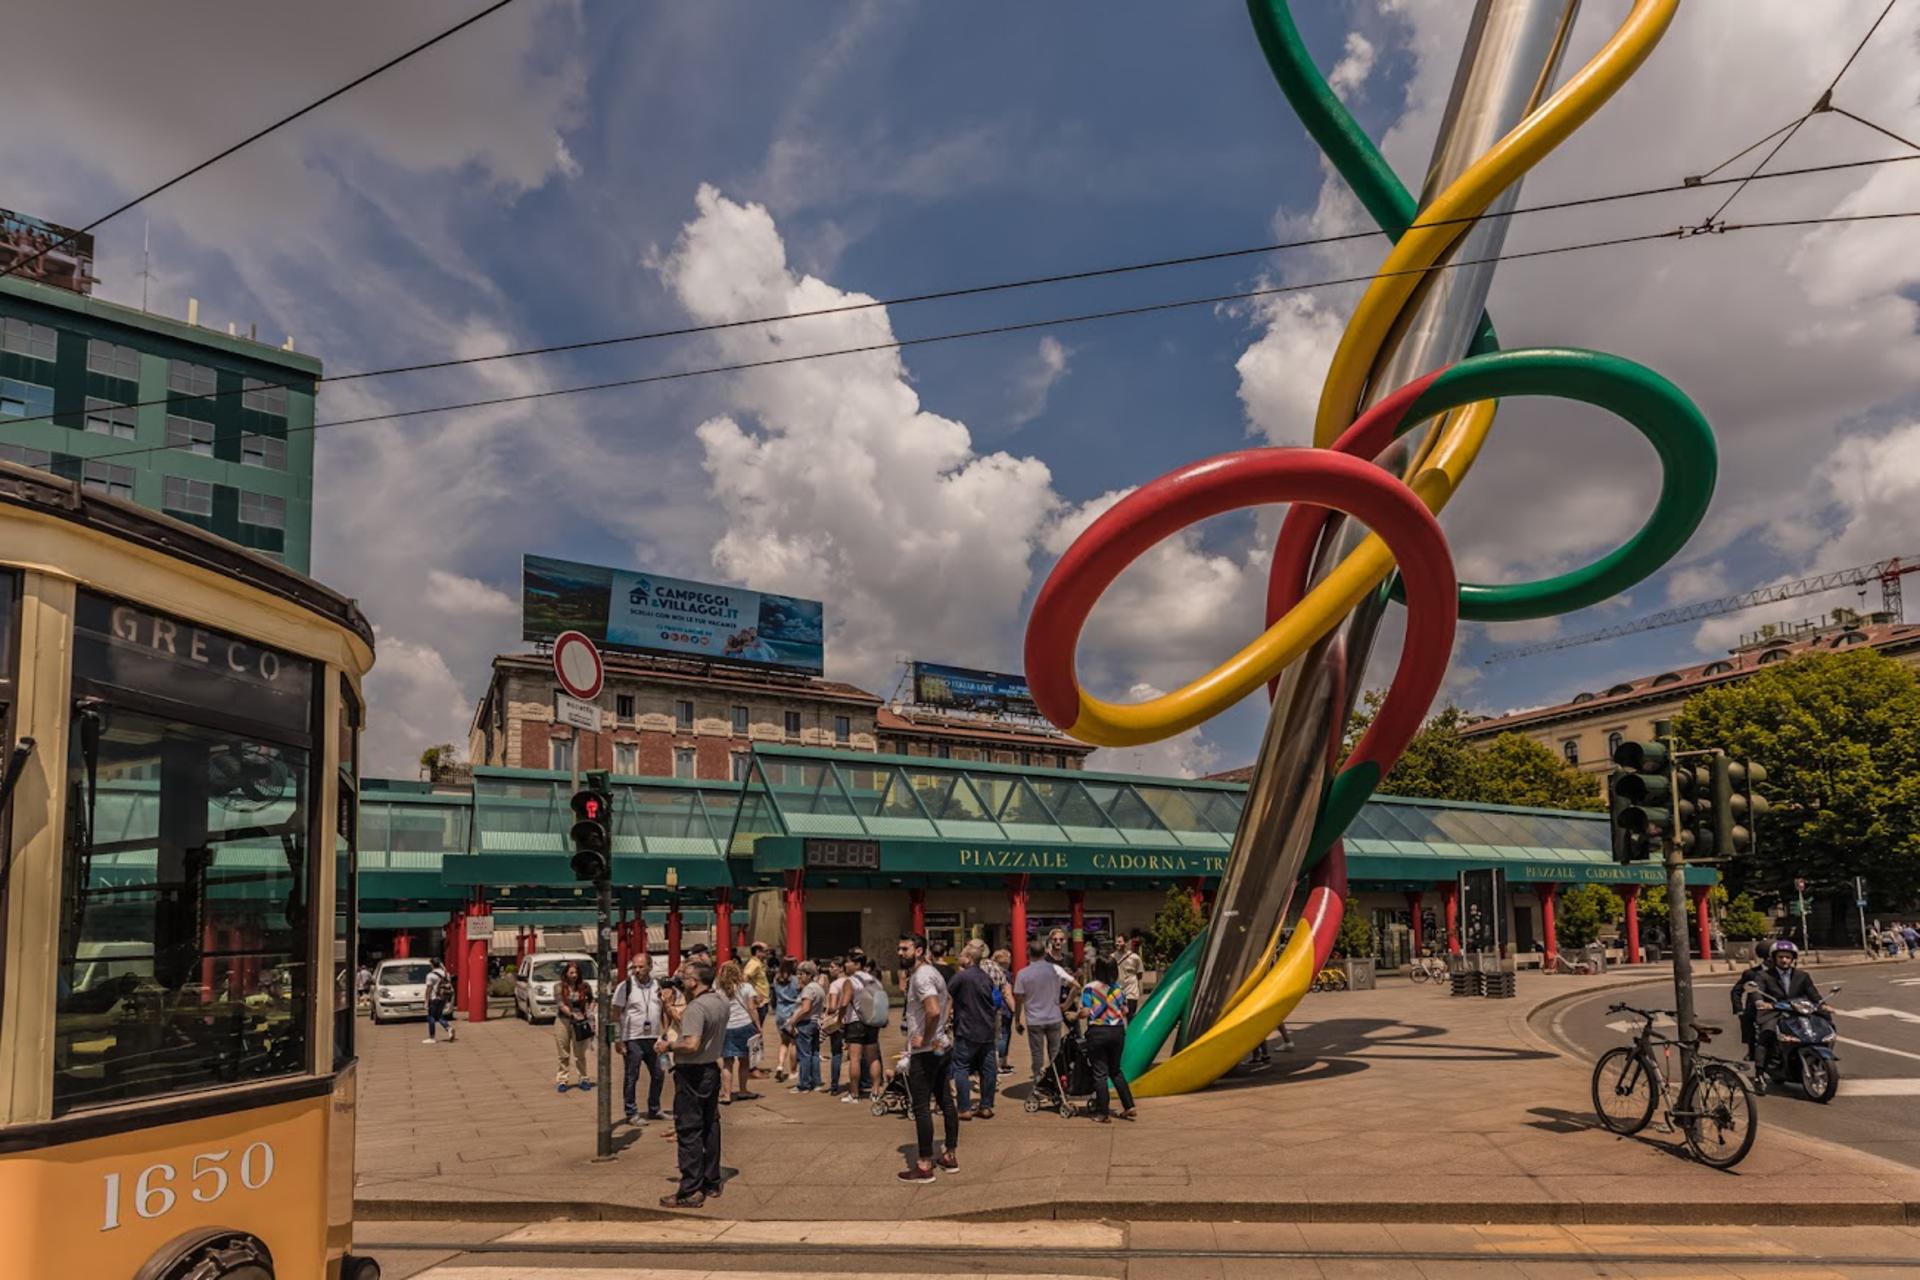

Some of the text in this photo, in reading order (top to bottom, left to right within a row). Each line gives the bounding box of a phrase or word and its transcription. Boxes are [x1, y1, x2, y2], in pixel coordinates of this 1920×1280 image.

[655, 586, 729, 607] CAMPEGGI
[111, 604, 280, 681] GRECO
[960, 849, 1068, 868] PIAZZALE
[1092, 853, 1186, 870] CADORNA
[1525, 866, 1576, 878] PIAZZALE
[1585, 867, 1632, 880] CADORNA
[99, 1141, 275, 1232] 1650
